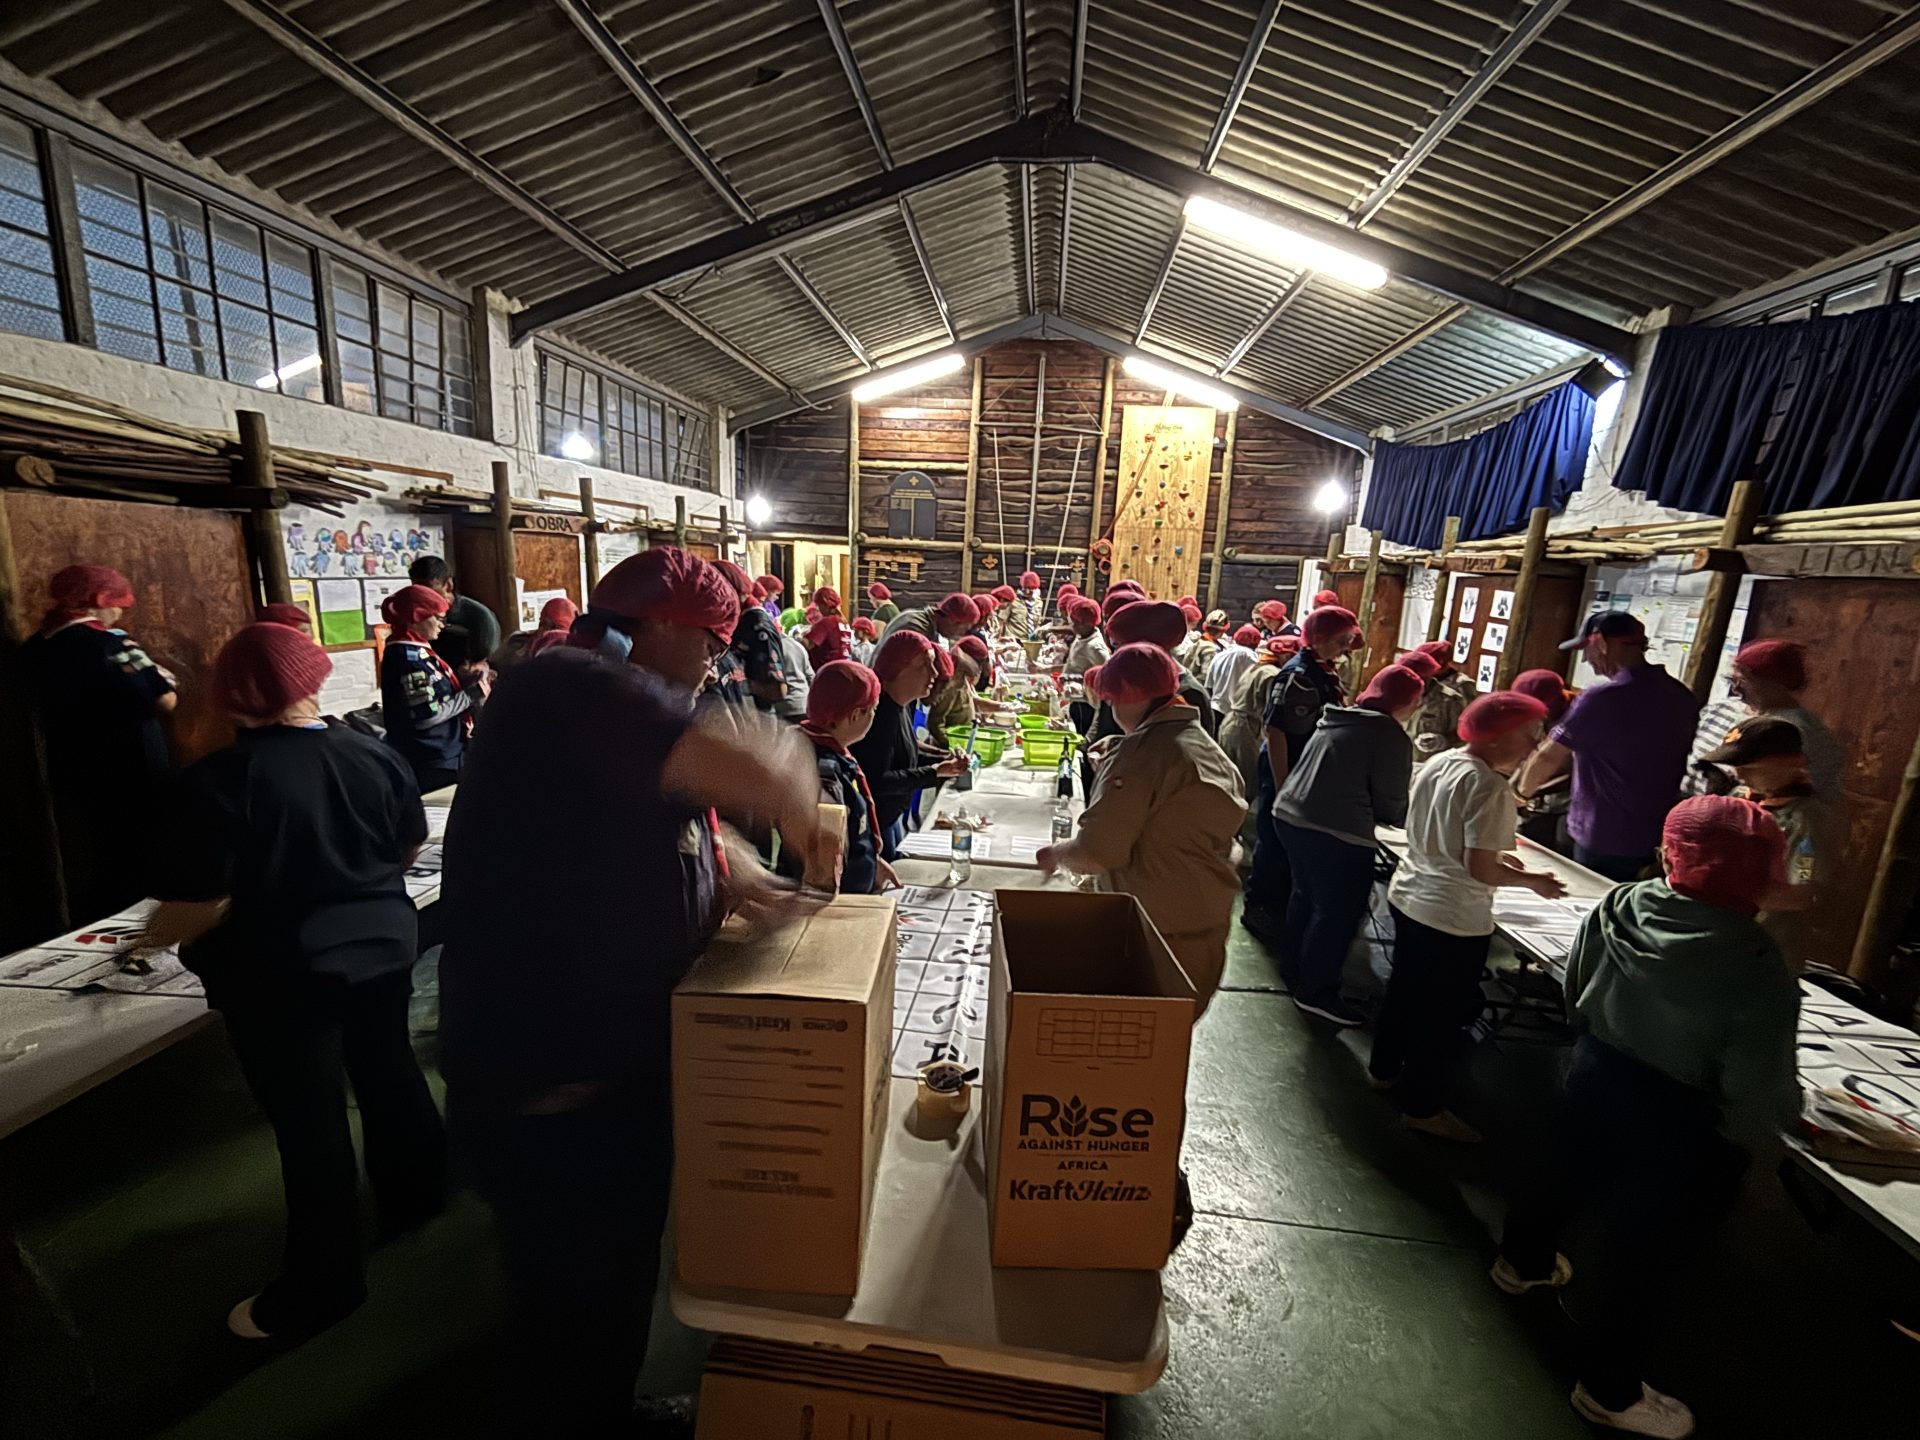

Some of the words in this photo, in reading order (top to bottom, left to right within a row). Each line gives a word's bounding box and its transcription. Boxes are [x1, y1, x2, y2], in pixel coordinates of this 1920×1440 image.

[530, 515, 574, 533] OBRA
[1019, 1094, 1154, 1138] Rise
[1017, 1139, 1083, 1151] AGAINST
[1087, 1140, 1150, 1152] HUNGER
[1057, 1160, 1109, 1170] AFRICA
